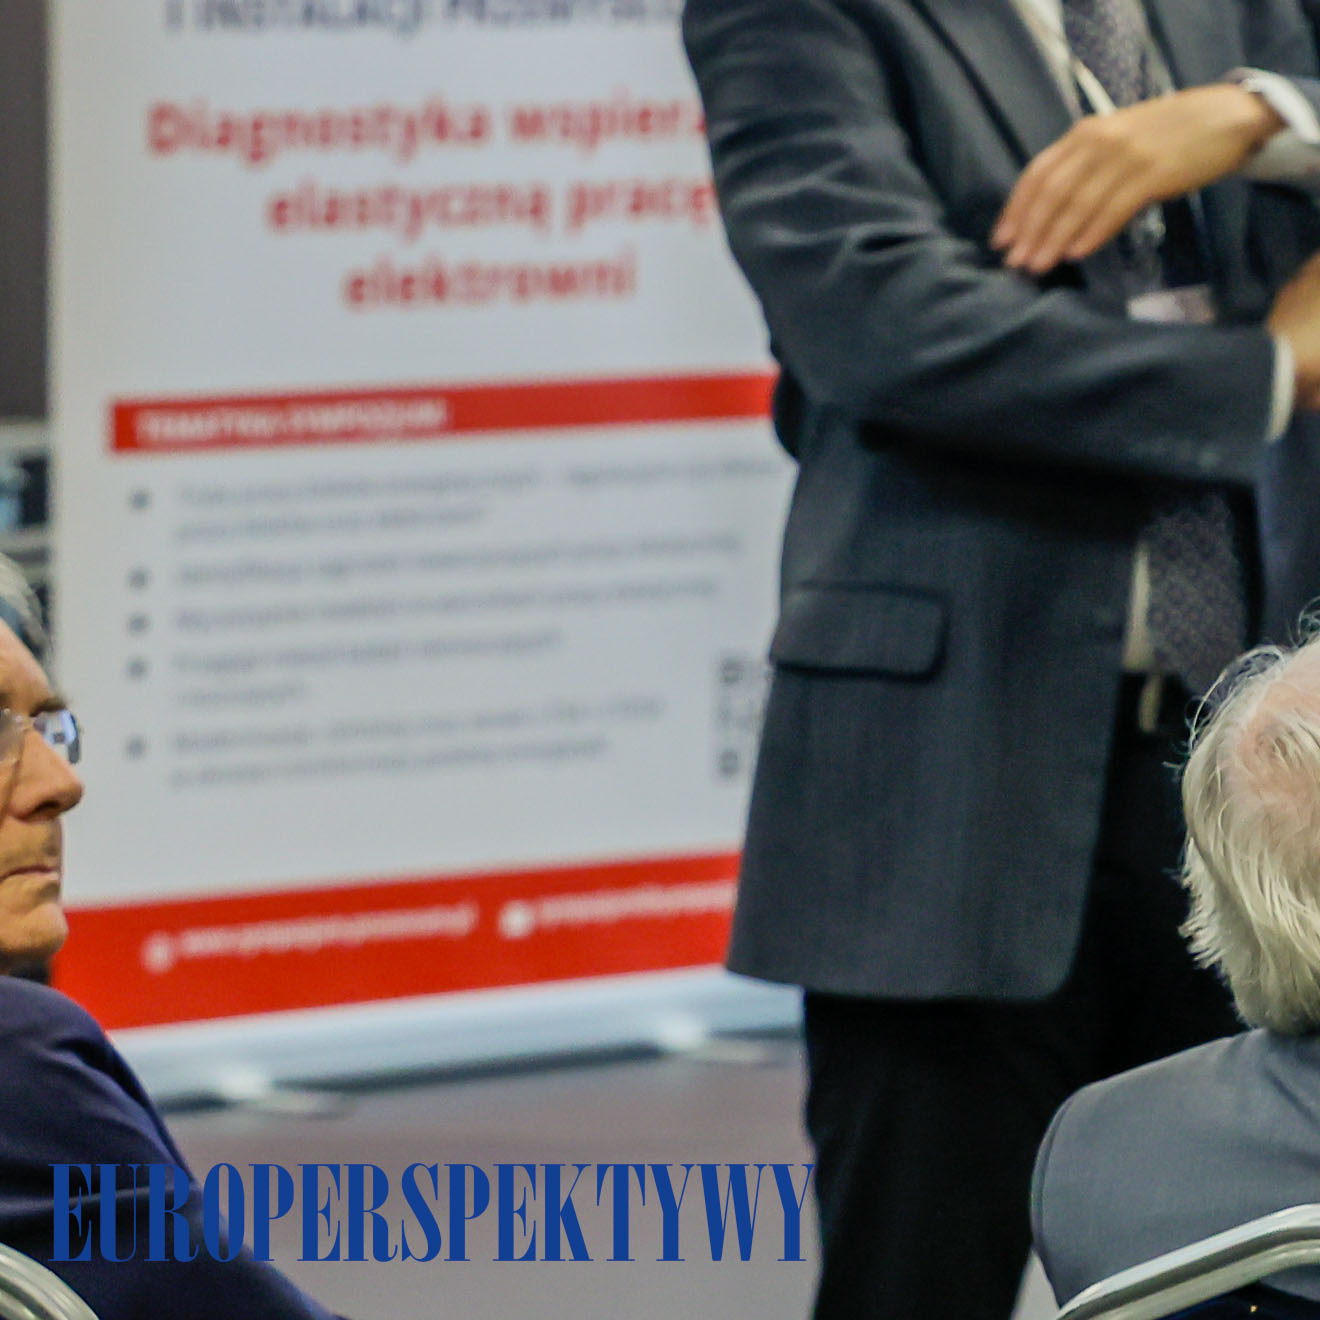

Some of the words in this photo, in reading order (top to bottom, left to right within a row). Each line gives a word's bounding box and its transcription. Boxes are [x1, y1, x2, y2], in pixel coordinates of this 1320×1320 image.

[150, 95, 490, 166] Diagnostyka
[268, 178, 548, 240] elastyczną
[344, 252, 634, 312] elektrowni
